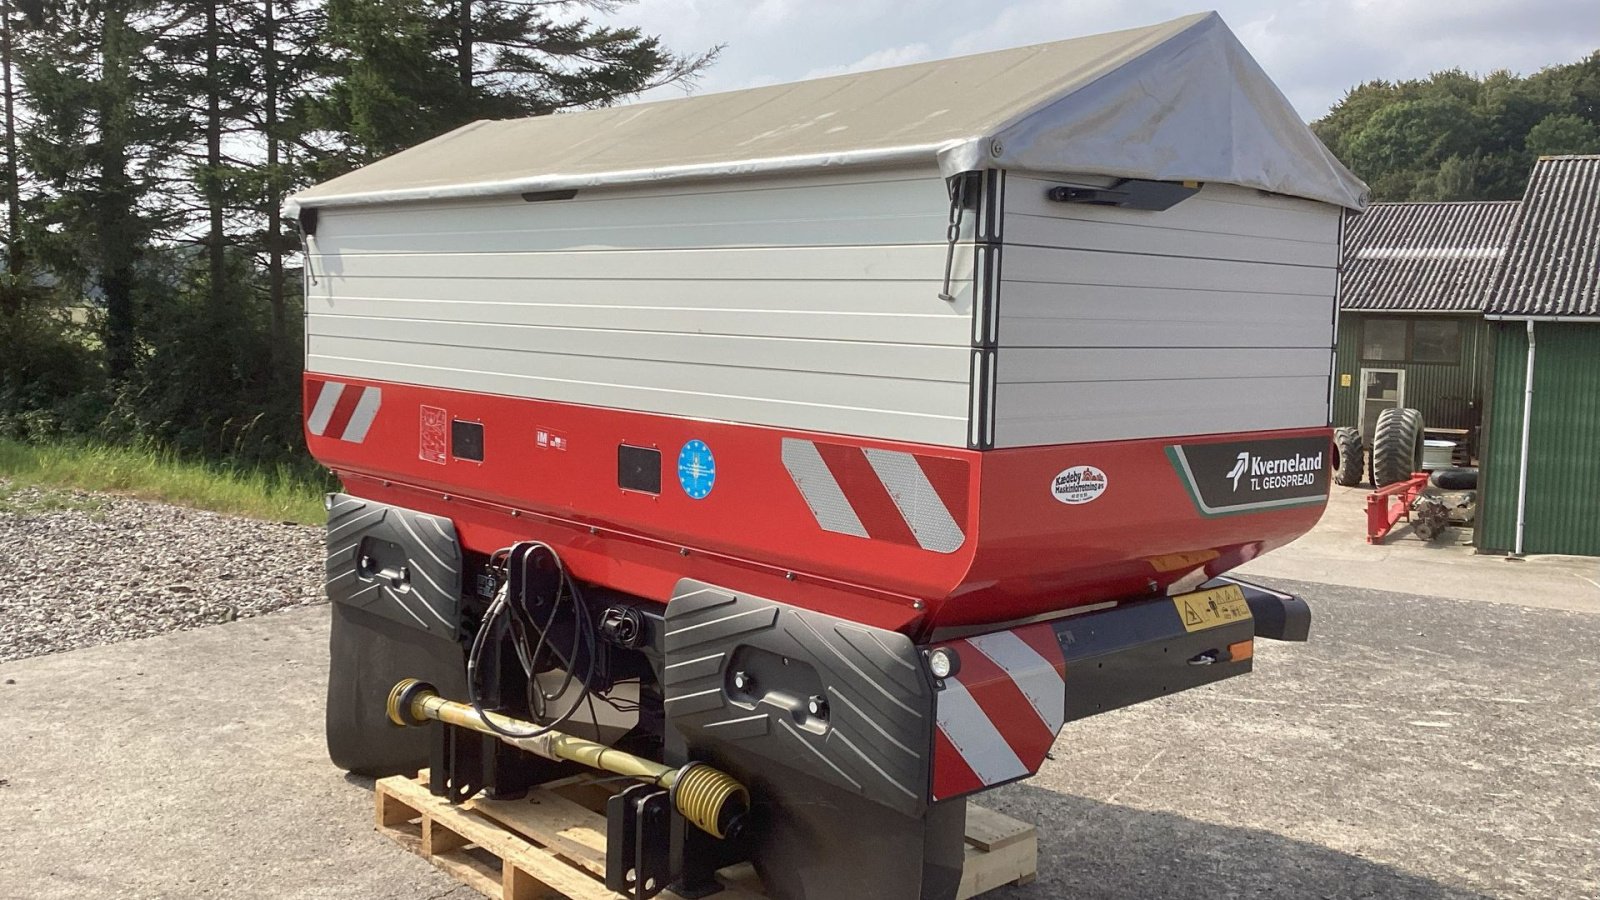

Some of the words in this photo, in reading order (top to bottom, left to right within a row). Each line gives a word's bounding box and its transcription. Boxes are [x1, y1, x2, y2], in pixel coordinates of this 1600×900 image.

[1251, 452, 1322, 476] Kverneland
[1251, 479, 1261, 491] TL
[1262, 473, 1315, 489] GEOSPREAD
